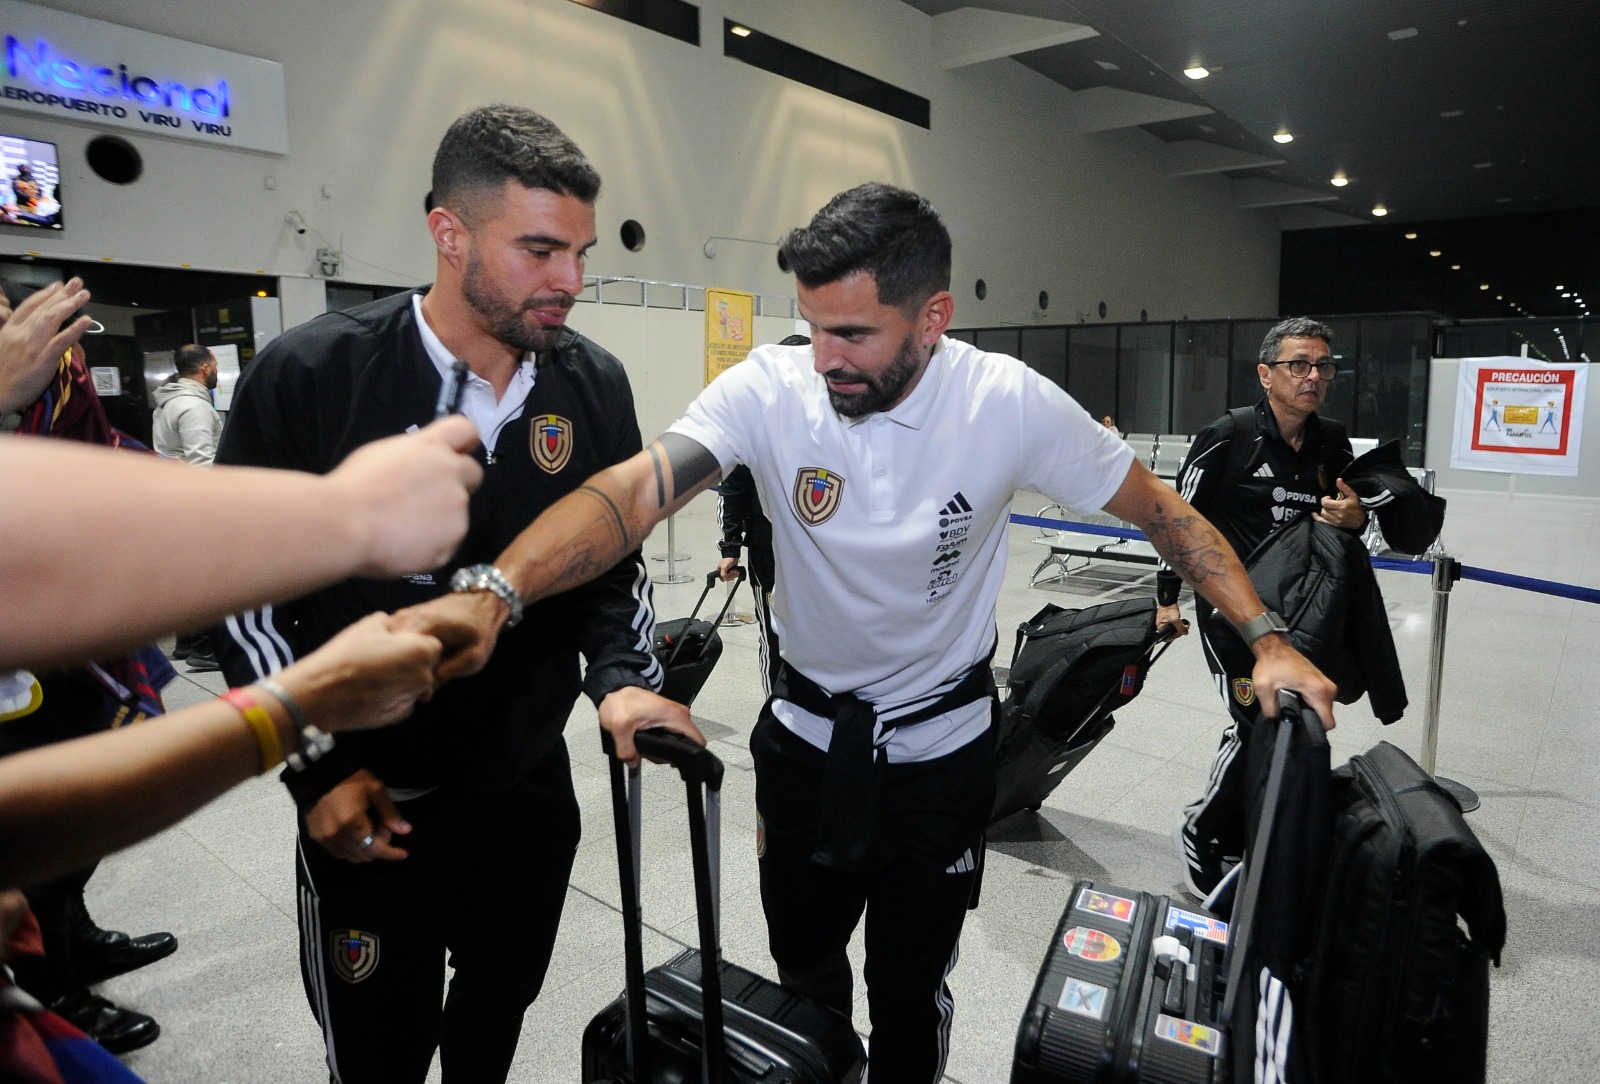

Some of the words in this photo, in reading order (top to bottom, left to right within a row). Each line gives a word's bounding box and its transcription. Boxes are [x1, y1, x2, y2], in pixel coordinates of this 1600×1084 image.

[6, 34, 230, 118] Nacional
[0, 86, 127, 118] EROPUERTO
[138, 110, 180, 128] VIRU
[192, 120, 231, 137] VIRU
[1491, 371, 1560, 383] PRECAUCIÓN
[1286, 491, 1317, 504] PDVSA
[949, 523, 971, 538] BDV
